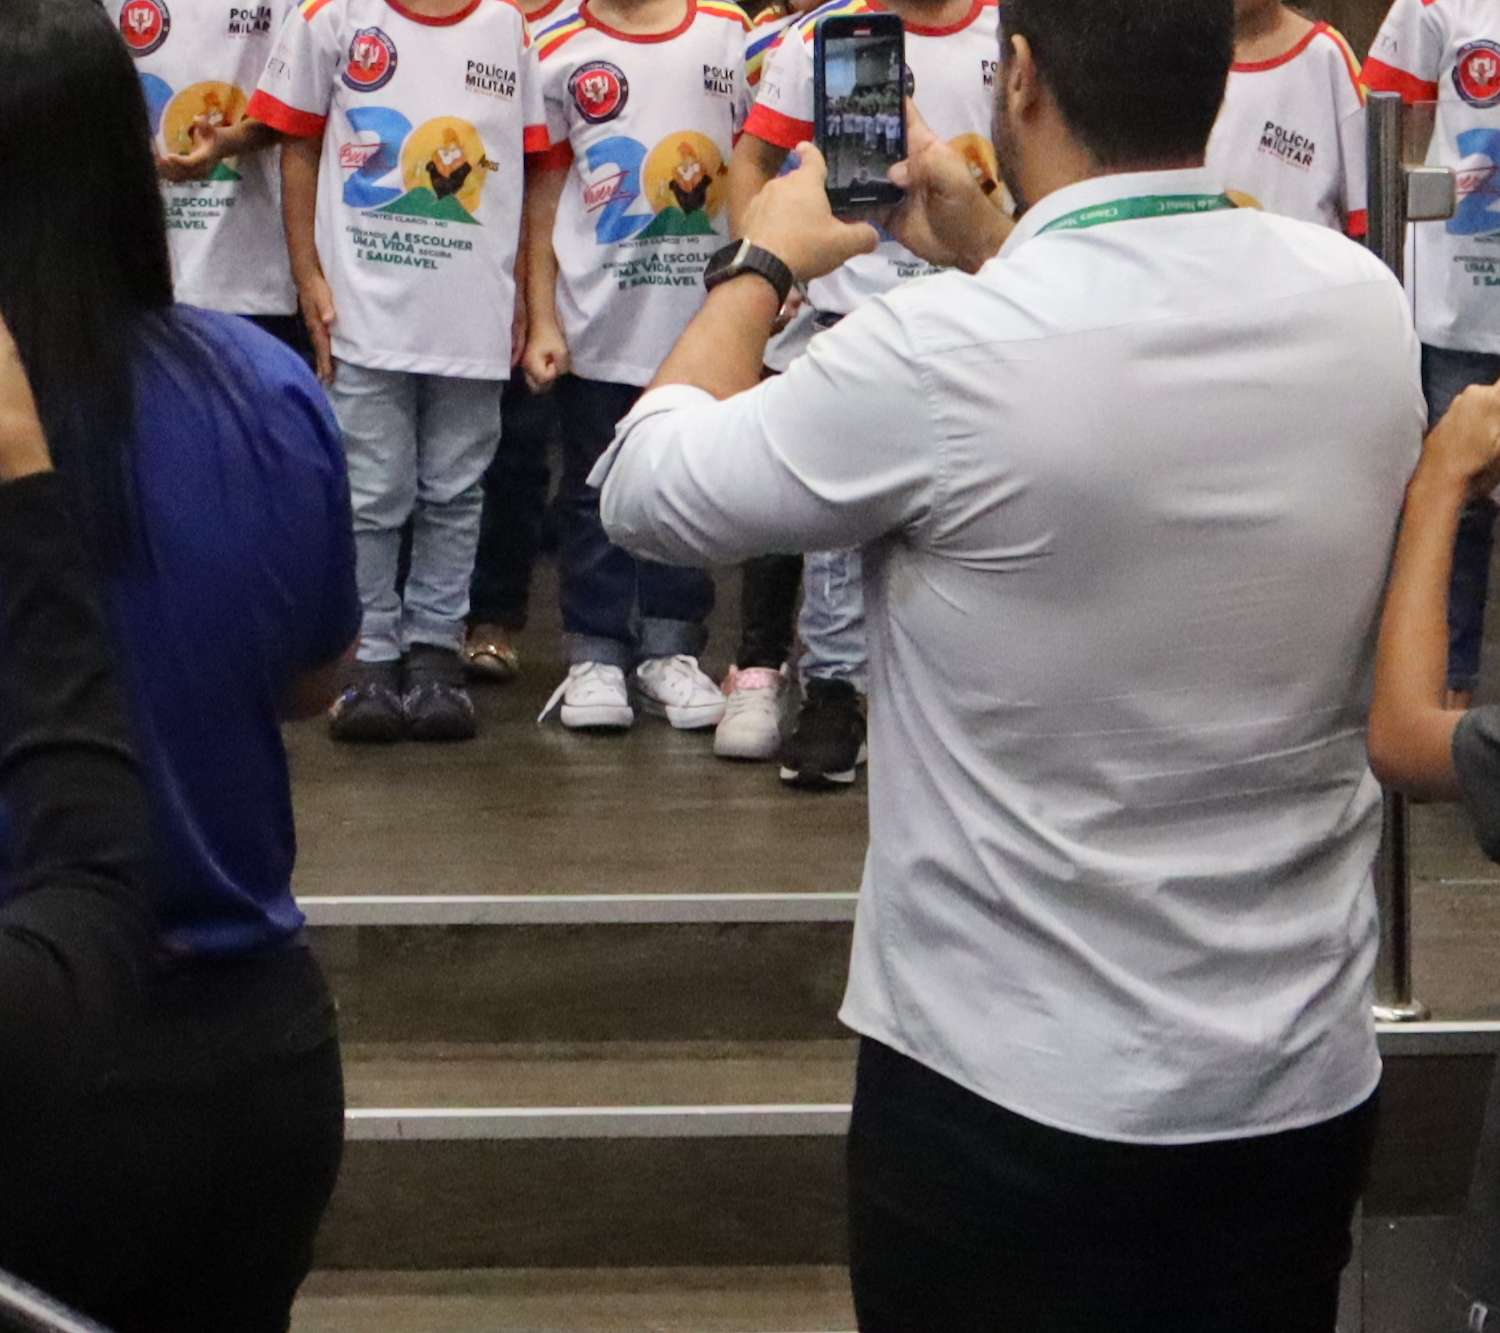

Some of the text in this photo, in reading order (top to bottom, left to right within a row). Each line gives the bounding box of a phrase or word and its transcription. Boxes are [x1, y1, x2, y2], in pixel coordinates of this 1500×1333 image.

[467, 59, 516, 84] POLÍCIA
[465, 73, 515, 97] MILITAR
[1263, 120, 1316, 155] POLÍCIA
[1259, 134, 1313, 166] MILITAR
[352, 234, 378, 250] UMA
[381, 238, 415, 254] VIDA
[391, 231, 401, 243] A
[404, 232, 474, 252] ESCOLHER
[365, 250, 439, 270] SAUDÁVEL
[651, 252, 660, 262] A
[630, 274, 698, 288] SAUDÁVEL
